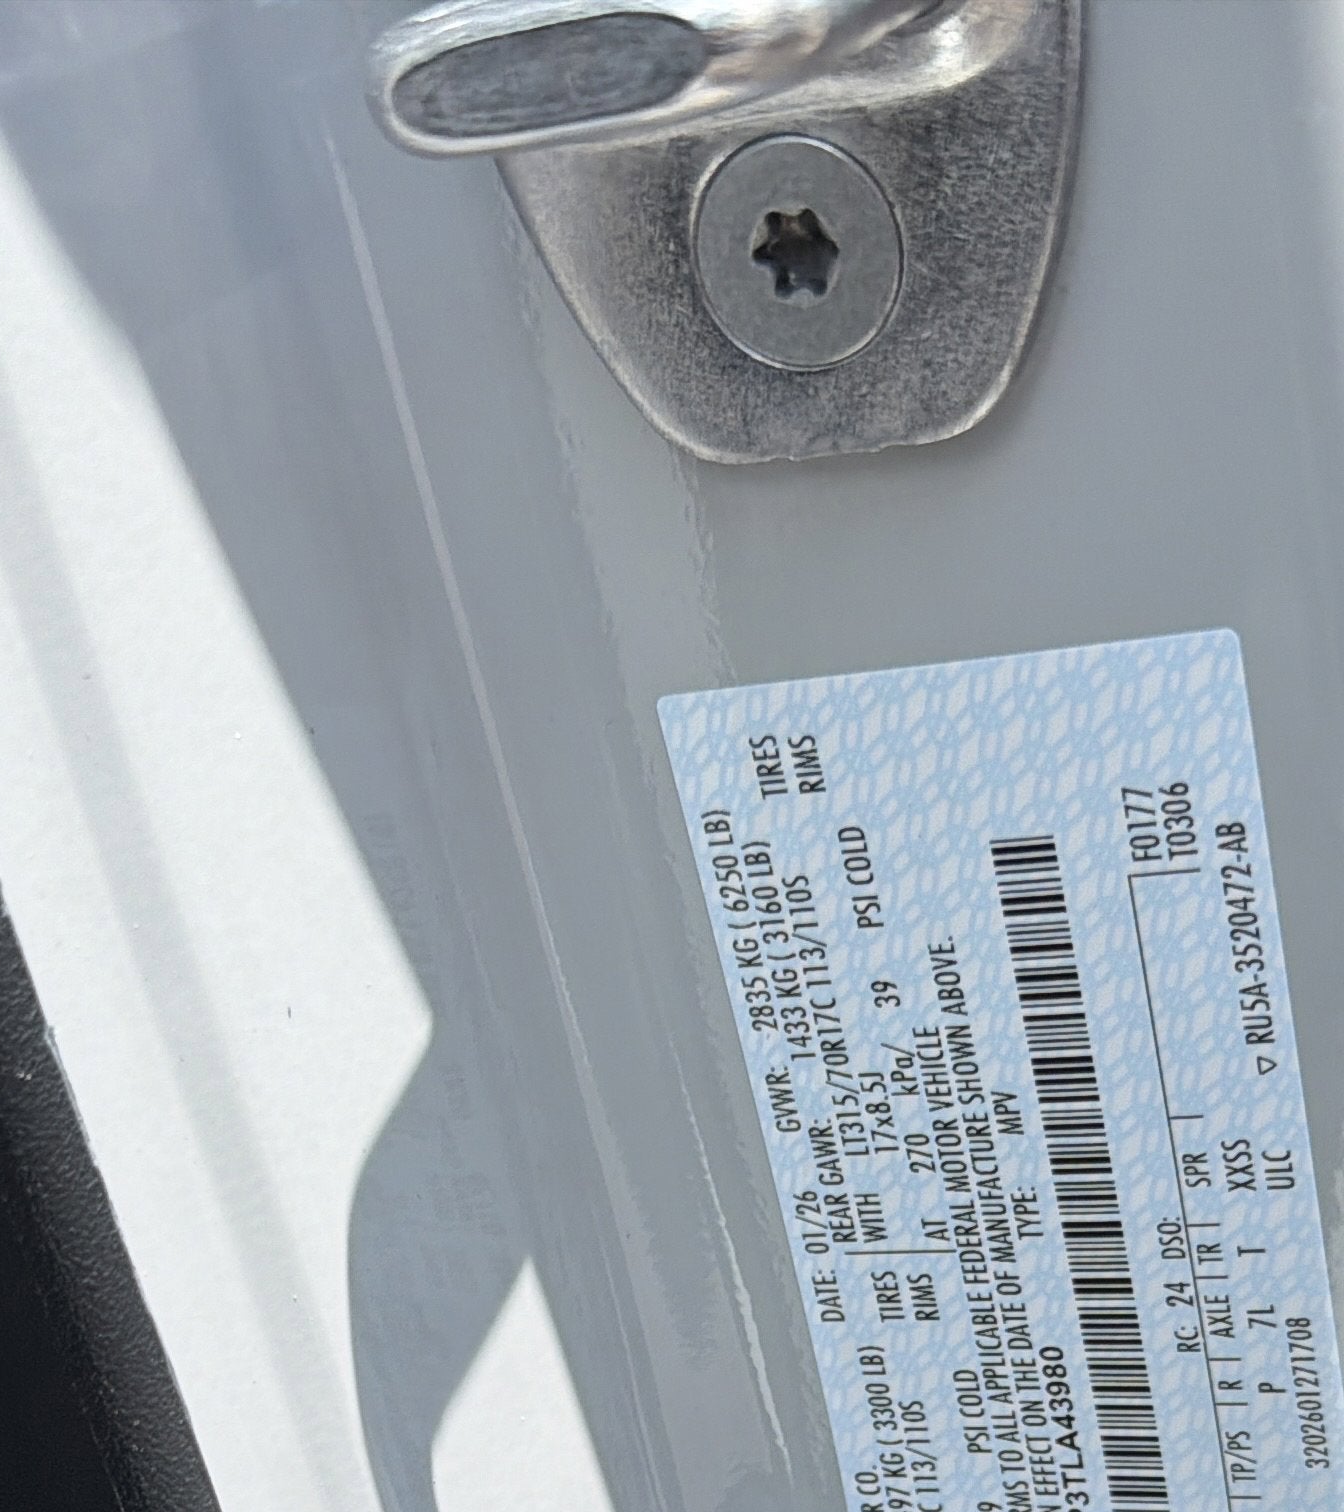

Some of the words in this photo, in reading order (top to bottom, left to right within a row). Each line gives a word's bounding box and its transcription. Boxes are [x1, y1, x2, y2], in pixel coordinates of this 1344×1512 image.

[747, 734, 789, 801] TIRES
[786, 734, 828, 795] RIMS
[699, 809, 735, 848] LB)
[1120, 786, 1164, 863] F0177
[1157, 781, 1200, 862] T0306
[740, 840, 775, 879] LB)
[836, 825, 875, 887] COLD
[710, 854, 751, 913] 6250
[750, 885, 790, 946] 3160
[780, 874, 833, 990] 113/110S
[850, 894, 886, 930] PSI
[1213, 821, 1277, 1046] RU5A-3520472-AB
[731, 937, 765, 970] KG
[926, 935, 970, 1017] ABOVE.
[739, 975, 779, 1033] 2835
[770, 967, 803, 999] KG
[869, 979, 902, 1009] 39
[779, 1005, 817, 1063] 1433
[808, 996, 871, 1157] LT315/70R17C
[879, 1042, 922, 1098] kPa/
[911, 1025, 955, 1114] VEHICLE
[944, 1023, 986, 1106] SHOWN
[763, 1065, 803, 1134] GVWR:
[857, 1071, 901, 1155] 17x8.5J
[989, 1090, 1026, 1137] MPV
[806, 1118, 846, 1187] GAWR:
[902, 1132, 937, 1175] 270
[931, 1117, 972, 1194] MOTOR
[1180, 1151, 1213, 1189] SPR
[1219, 1138, 1258, 1193] XXSS
[1260, 1149, 1296, 1191] ULC
[961, 1111, 1018, 1264] MANUFACTURE
[1009, 1185, 1045, 1242] TYPE:
[791, 1189, 831, 1256] 01/26
[822, 1192, 859, 1244] REAR
[853, 1192, 890, 1244] WITH
[919, 1217, 951, 1243] AT
[948, 1199, 991, 1285] FEDERAL
[1155, 1216, 1187, 1261] DSO:
[810, 1268, 847, 1323] DATE:
[869, 1270, 906, 1324] TIRES
[905, 1272, 941, 1322] RIMS
[993, 1270, 1023, 1297] OF
[1162, 1281, 1195, 1308] 24
[998, 1302, 1034, 1351] DATE
[1172, 1325, 1202, 1354] RC:
[1202, 1293, 1236, 1340] AXLE
[1245, 1303, 1278, 1330] 7L
[855, 1345, 888, 1377] LB)
[965, 1291, 1015, 1405] APPLICABLE
[951, 1368, 986, 1419] COLD
[1009, 1357, 1042, 1394] THE
[1284, 1316, 1331, 1470] 3202601271708
[863, 1382, 899, 1432] 3300
[989, 1410, 1022, 1444] ALL
[1018, 1399, 1048, 1428] ON
[878, 1452, 908, 1479] KG
[897, 1399, 941, 1495] 113/110S
[962, 1425, 994, 1454] PSI
[996, 1448, 1027, 1475] TO
[1024, 1433, 1061, 1497] EFFECT
[1223, 1429, 1258, 1484] TP/PS
[853, 1464, 882, 1497] CO.
